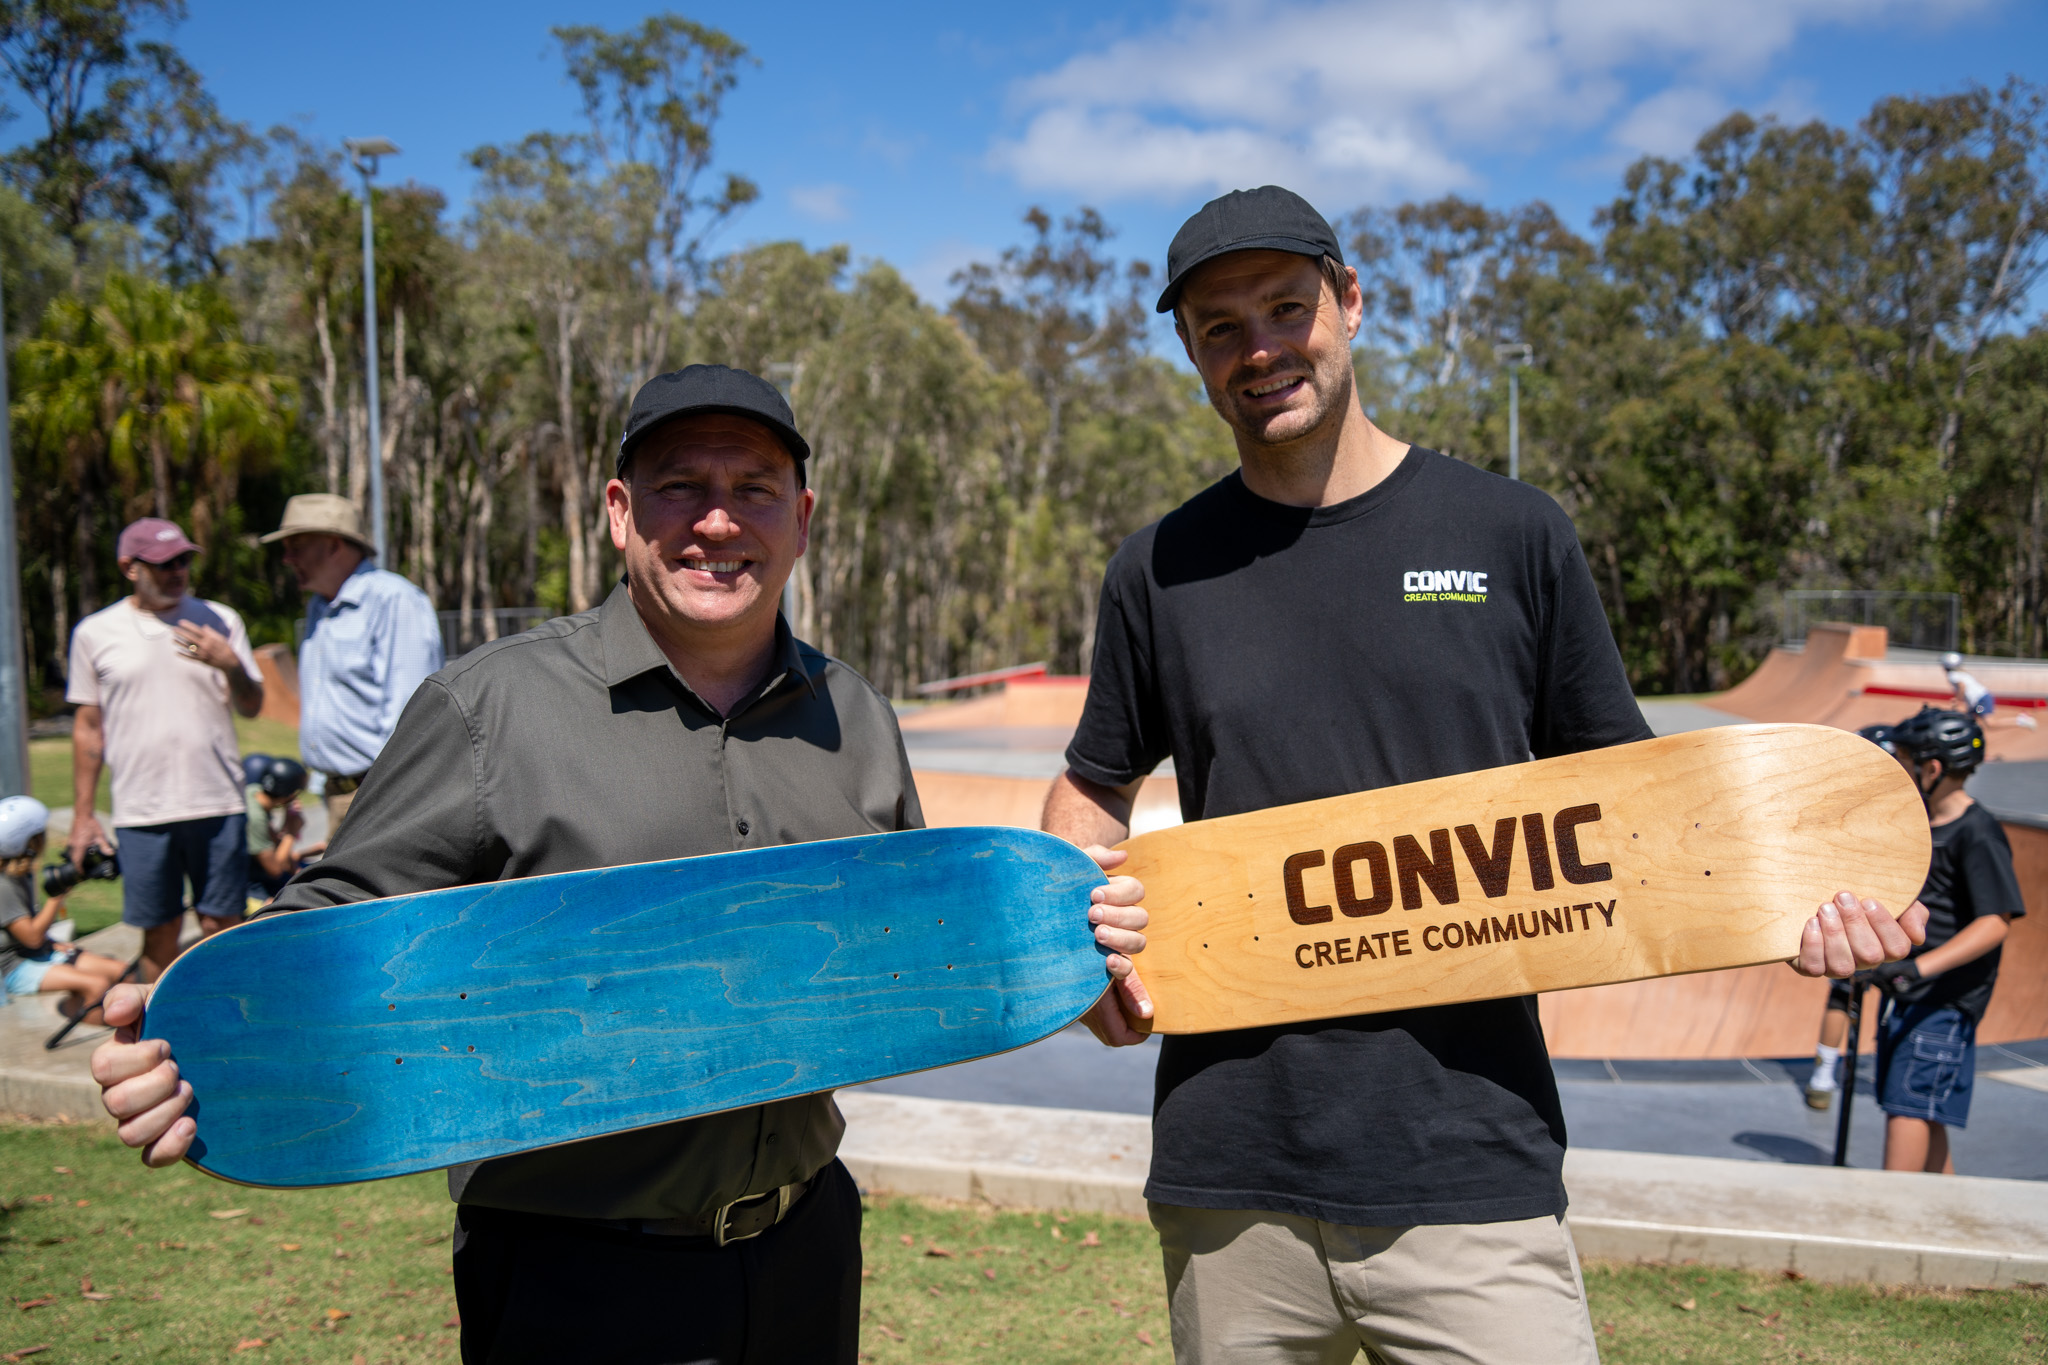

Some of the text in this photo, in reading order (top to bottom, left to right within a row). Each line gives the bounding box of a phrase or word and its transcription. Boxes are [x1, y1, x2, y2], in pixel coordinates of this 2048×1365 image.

[1403, 570, 1488, 592] CONVIC
[1404, 592, 1487, 603] CREATE COMMUNITY
[1283, 803, 1613, 925] CONVIC
[1295, 899, 1617, 968] CREATE COMMUNITY
